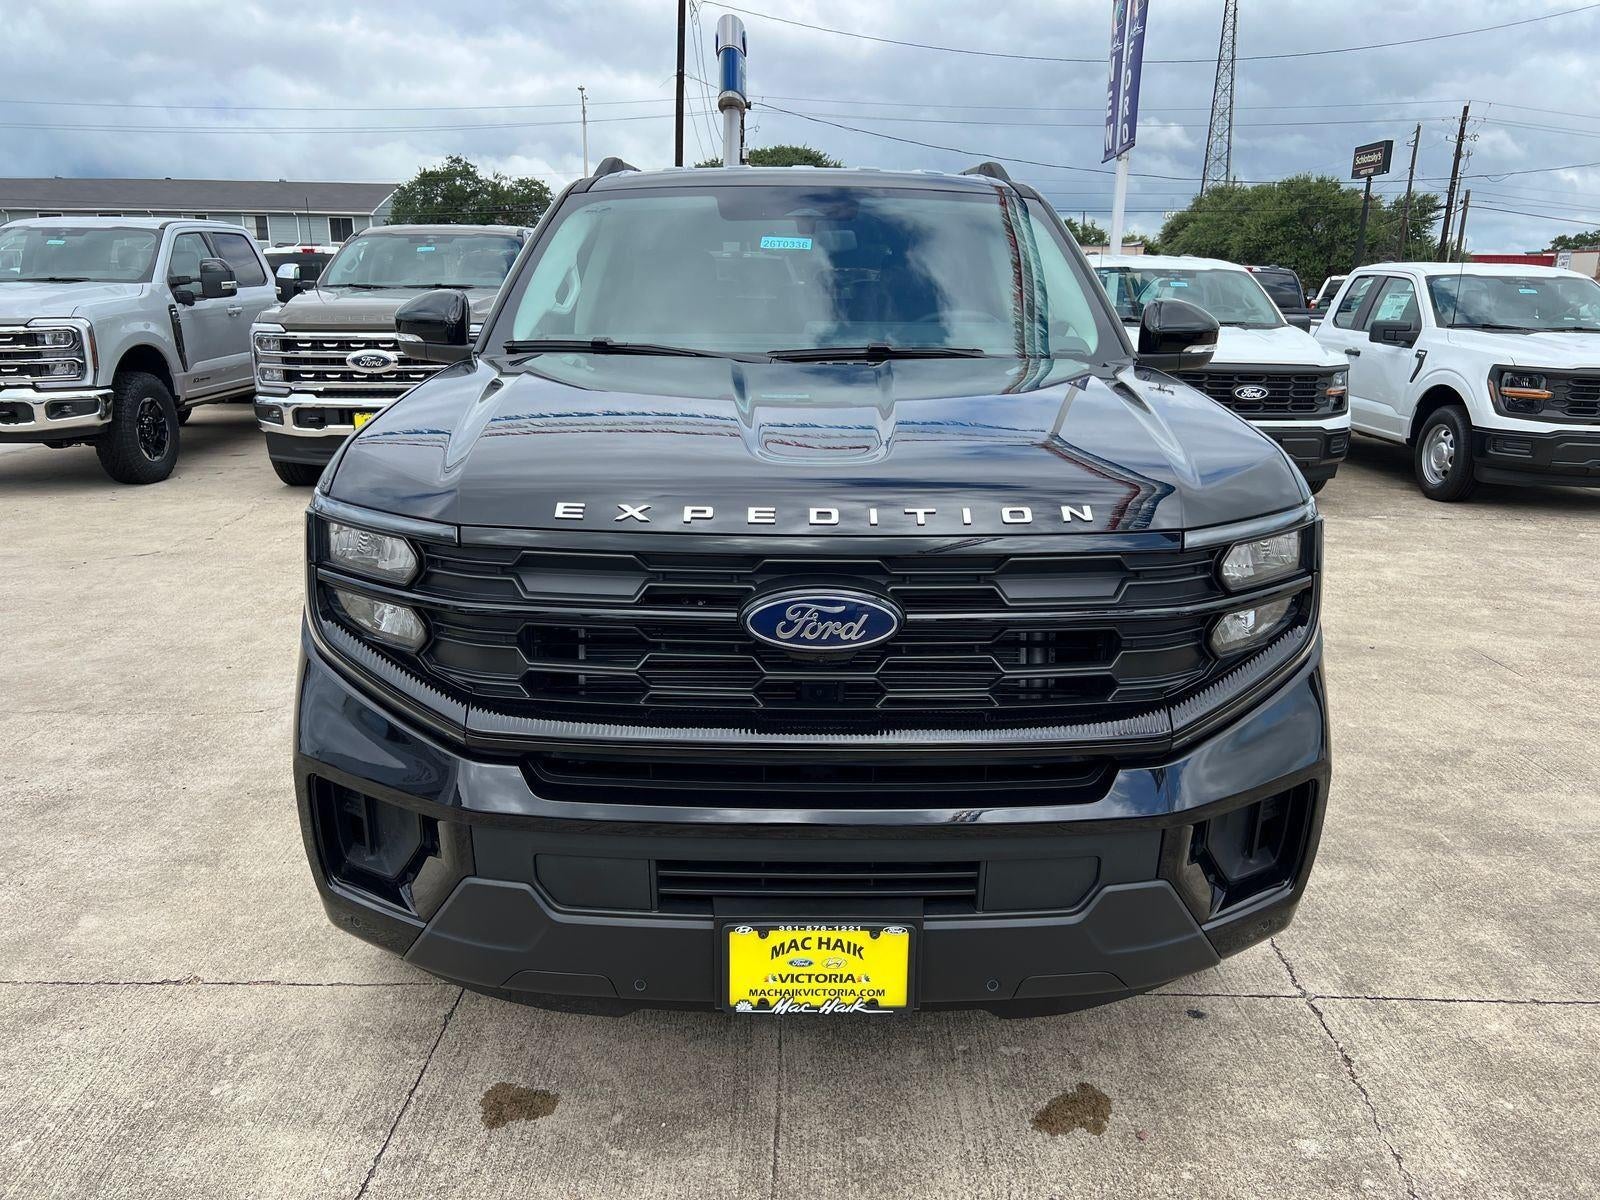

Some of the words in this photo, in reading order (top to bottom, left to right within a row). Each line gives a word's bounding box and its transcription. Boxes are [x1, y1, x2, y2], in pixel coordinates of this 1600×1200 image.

[1122, 40, 1135, 144] FORD
[360, 355, 383, 367] Ford
[1241, 388, 1262, 398] Ford
[554, 502, 1094, 525] EXPEDITION
[775, 603, 869, 641] Ford
[770, 936, 812, 960] MAC
[817, 936, 864, 960] HAIK
[778, 973, 857, 983] VICTORIA
[749, 988, 886, 997] MACHAIKVICTORIA.COM
[772, 997, 817, 1014] Mac
[818, 997, 869, 1014] Haik
